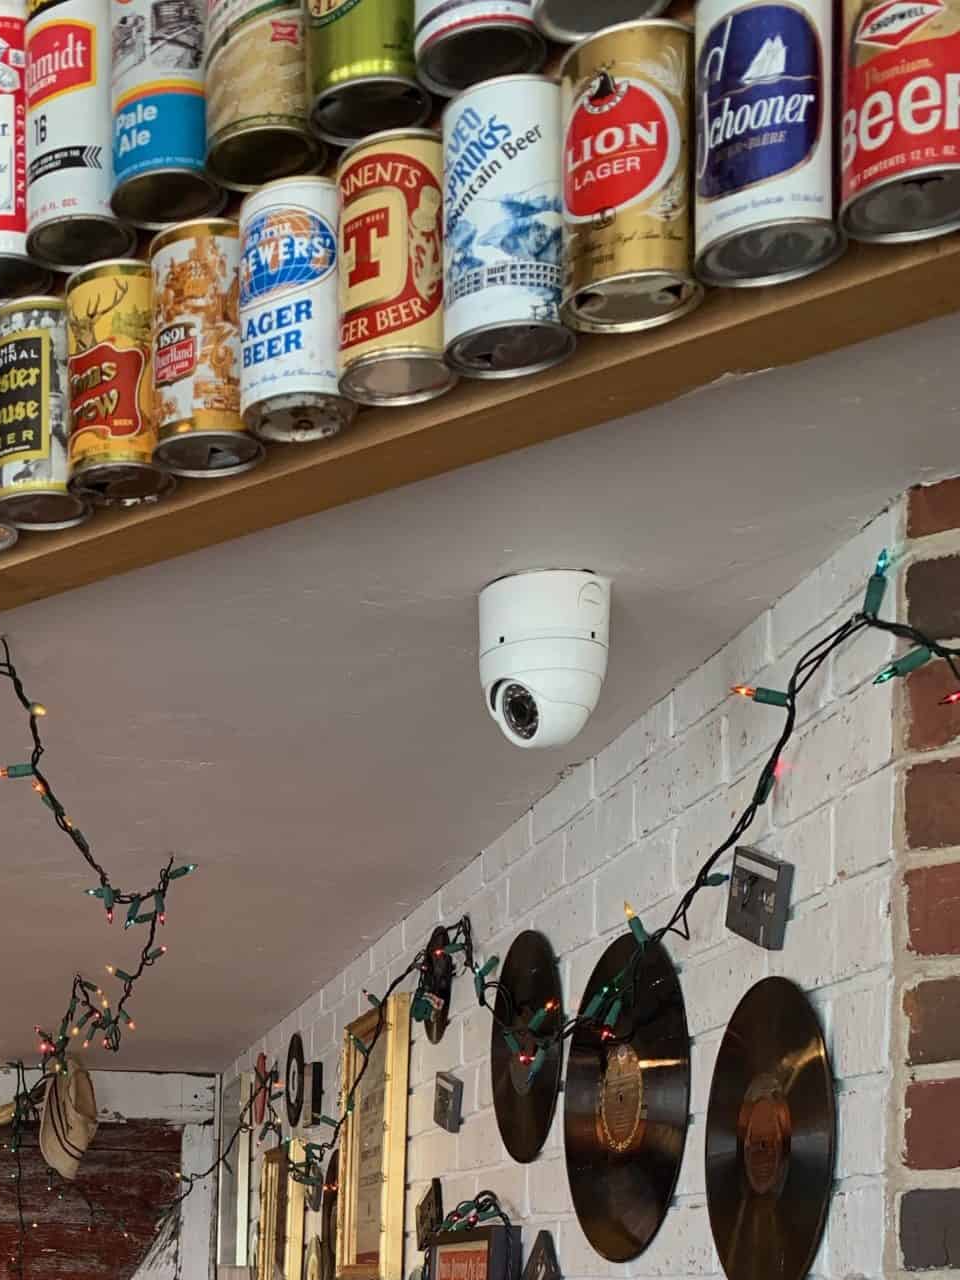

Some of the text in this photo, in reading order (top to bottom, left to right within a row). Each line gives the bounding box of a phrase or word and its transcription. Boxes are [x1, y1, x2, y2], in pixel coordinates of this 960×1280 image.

[116, 104, 158, 137] Pale
[16, 103, 25, 209] GENUINE
[119, 130, 151, 157] Ale
[502, 124, 544, 160] Beer
[567, 121, 659, 174] LION
[574, 156, 641, 191] LAGER
[376, 298, 427, 331] BEER
[243, 329, 302, 368] BEER
